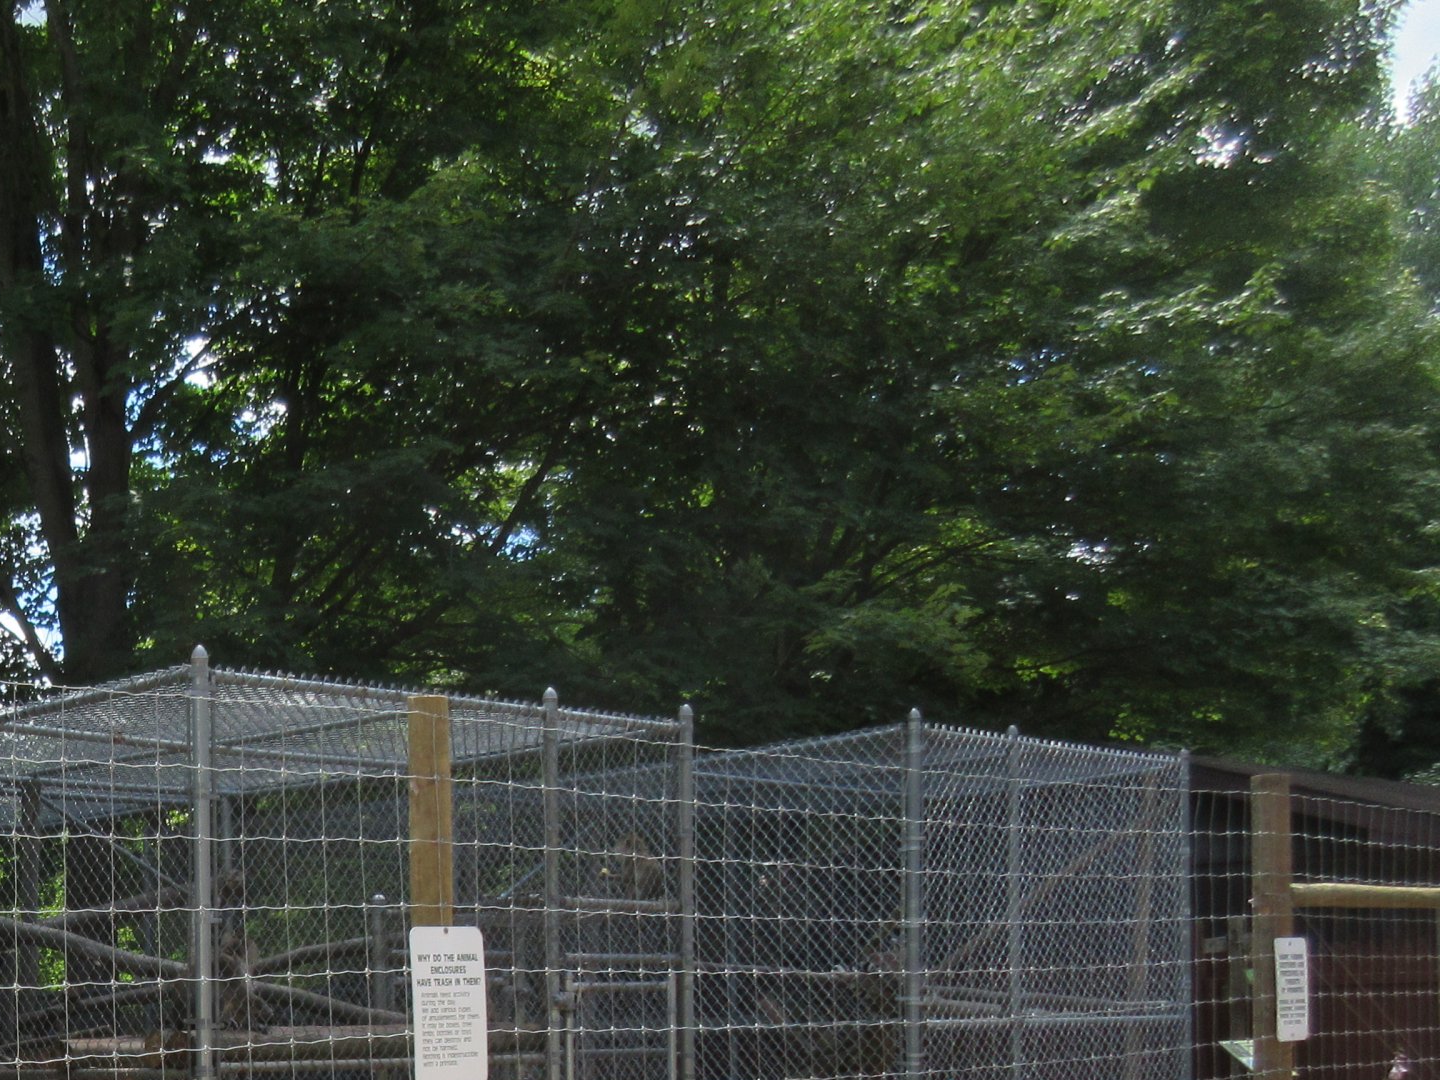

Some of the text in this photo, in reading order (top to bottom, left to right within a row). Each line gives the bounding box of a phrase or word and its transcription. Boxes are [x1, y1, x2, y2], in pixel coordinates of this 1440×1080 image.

[417, 953, 478, 962] WHY DO THE ANIMAL
[430, 966, 467, 974] ENCLOSURES
[416, 978, 432, 987] HAVE
[433, 978, 453, 986] TRASH
[454, 978, 461, 986] IN
